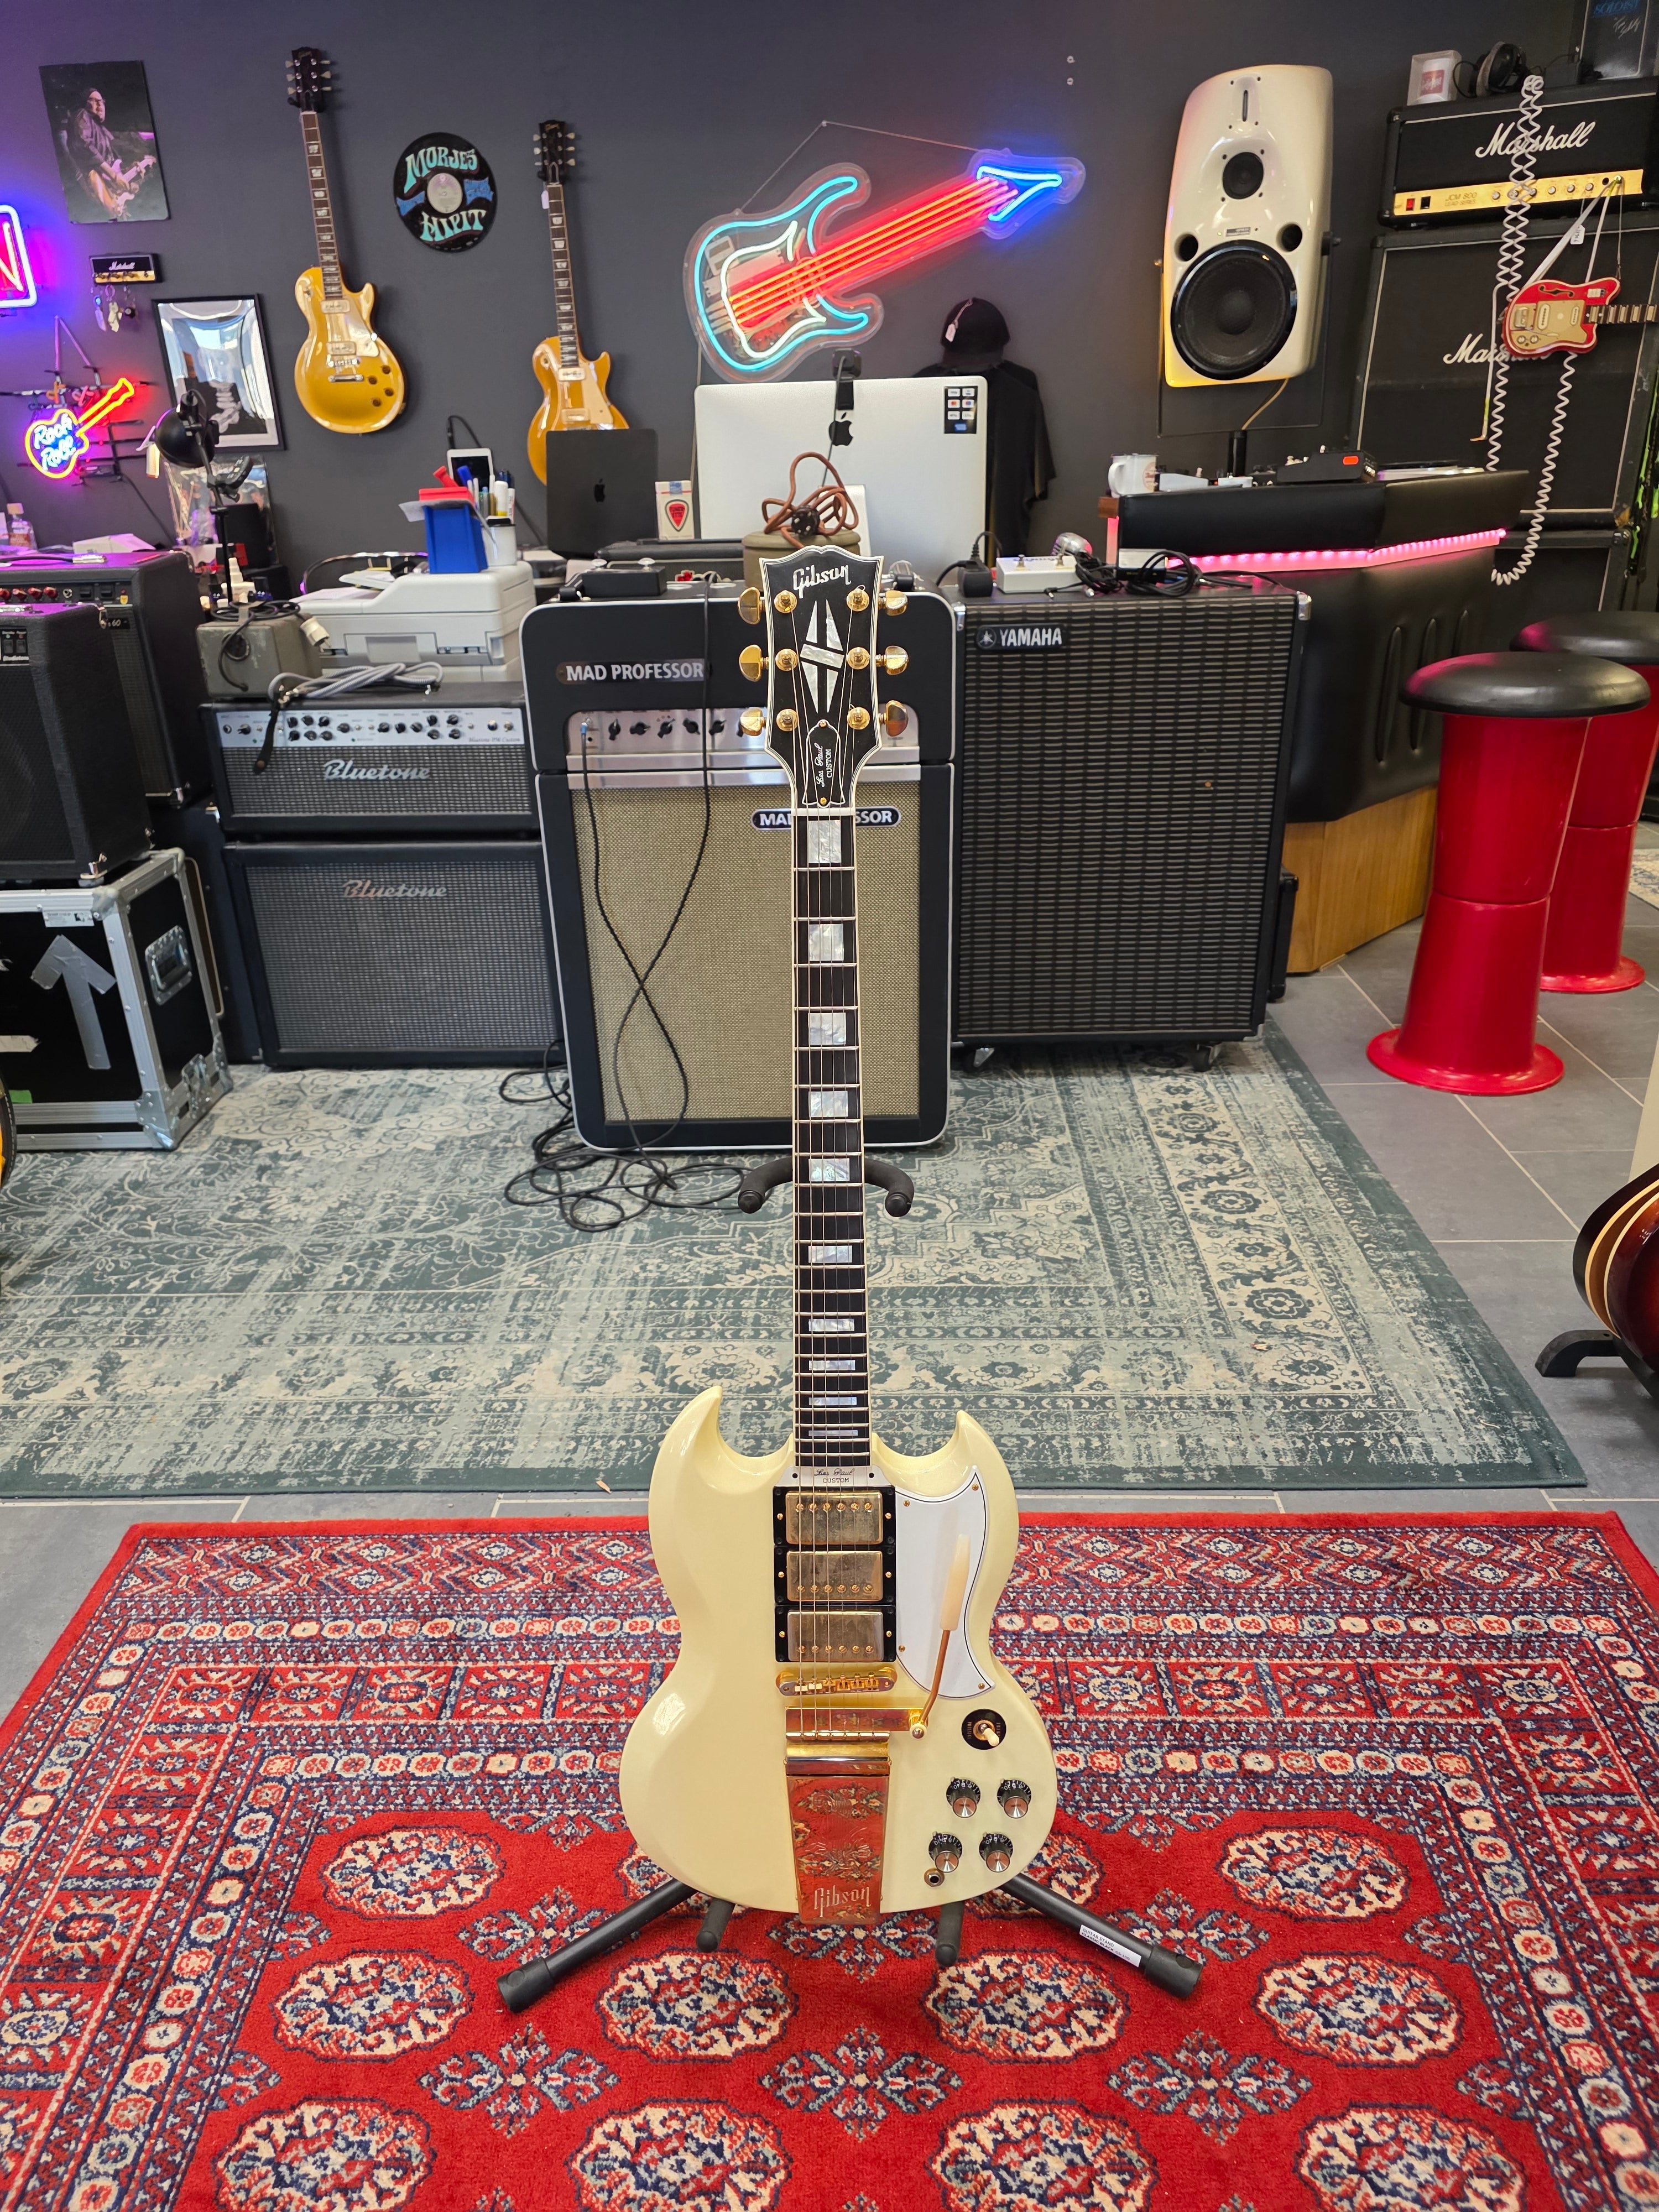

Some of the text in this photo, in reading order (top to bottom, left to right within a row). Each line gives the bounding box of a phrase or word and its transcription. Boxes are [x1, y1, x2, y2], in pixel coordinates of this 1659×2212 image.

[1475, 122, 1596, 158] Marshall
[404, 147, 478, 194] MORJES
[420, 210, 487, 242] HIPIT
[793, 565, 852, 599] Gibson
[999, 628, 1062, 646] YAMAHA
[566, 662, 704, 681] MAD PROFESSOR
[324, 758, 430, 780] Bluetone
[759, 812, 791, 826] MA
[343, 879, 447, 898] Bluetone
[814, 1885, 872, 1918] Gibson
[1082, 1928, 1114, 1947] GUITAR STAND
[1082, 1932, 1099, 1943] CLASSIC
[1099, 1942, 1114, 1952] BLACK
